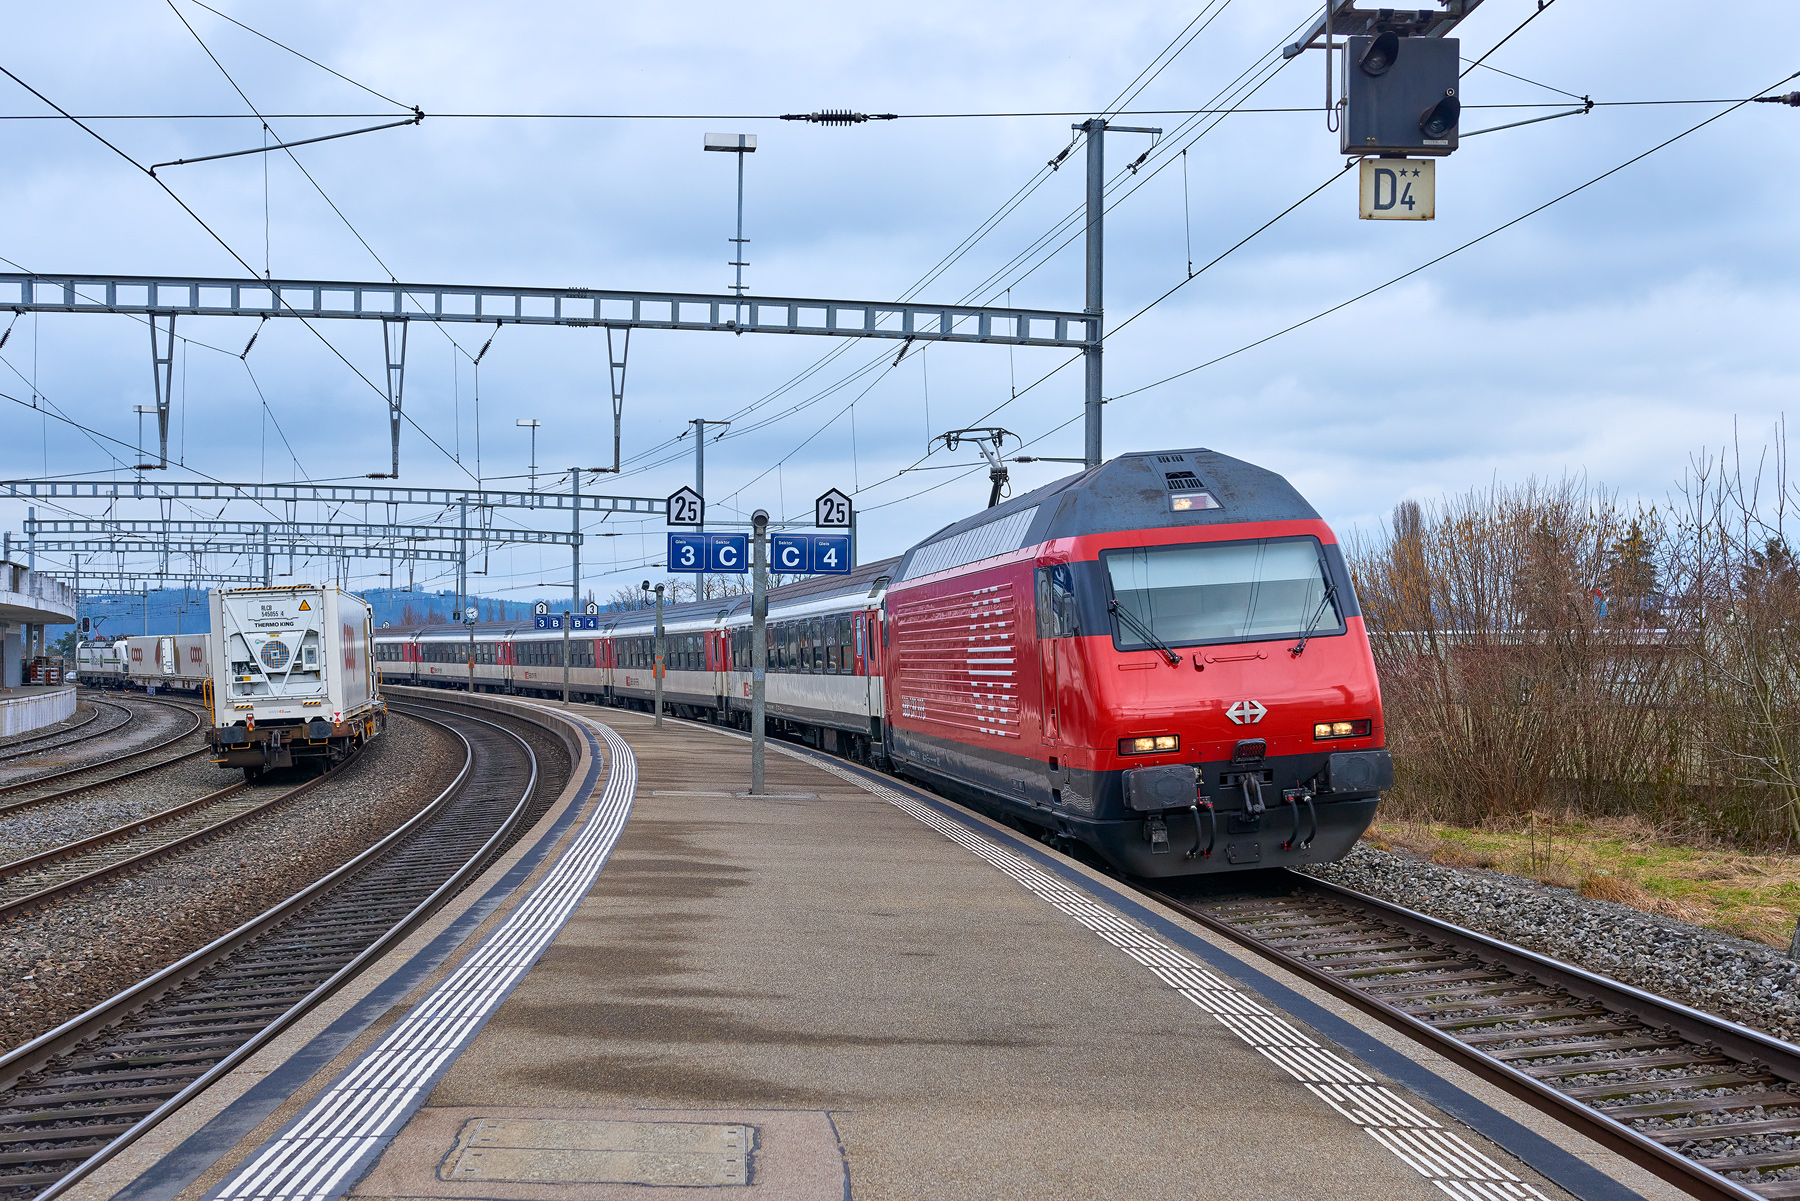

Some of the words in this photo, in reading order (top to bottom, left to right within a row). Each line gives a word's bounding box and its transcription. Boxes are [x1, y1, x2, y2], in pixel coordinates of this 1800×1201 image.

[674, 495, 697, 521] 25
[823, 497, 846, 523] 25
[680, 545, 695, 566] 3
[719, 545, 737, 566] C
[781, 546, 800, 567] C
[823, 547, 838, 567] 4
[538, 604, 544, 614] 3
[589, 604, 595, 614] 3
[539, 620, 545, 628] 3
[552, 620, 559, 628] B
[574, 620, 581, 628] B
[588, 620, 595, 628] 4
[131, 647, 143, 666] coop
[190, 646, 203, 668] coop
